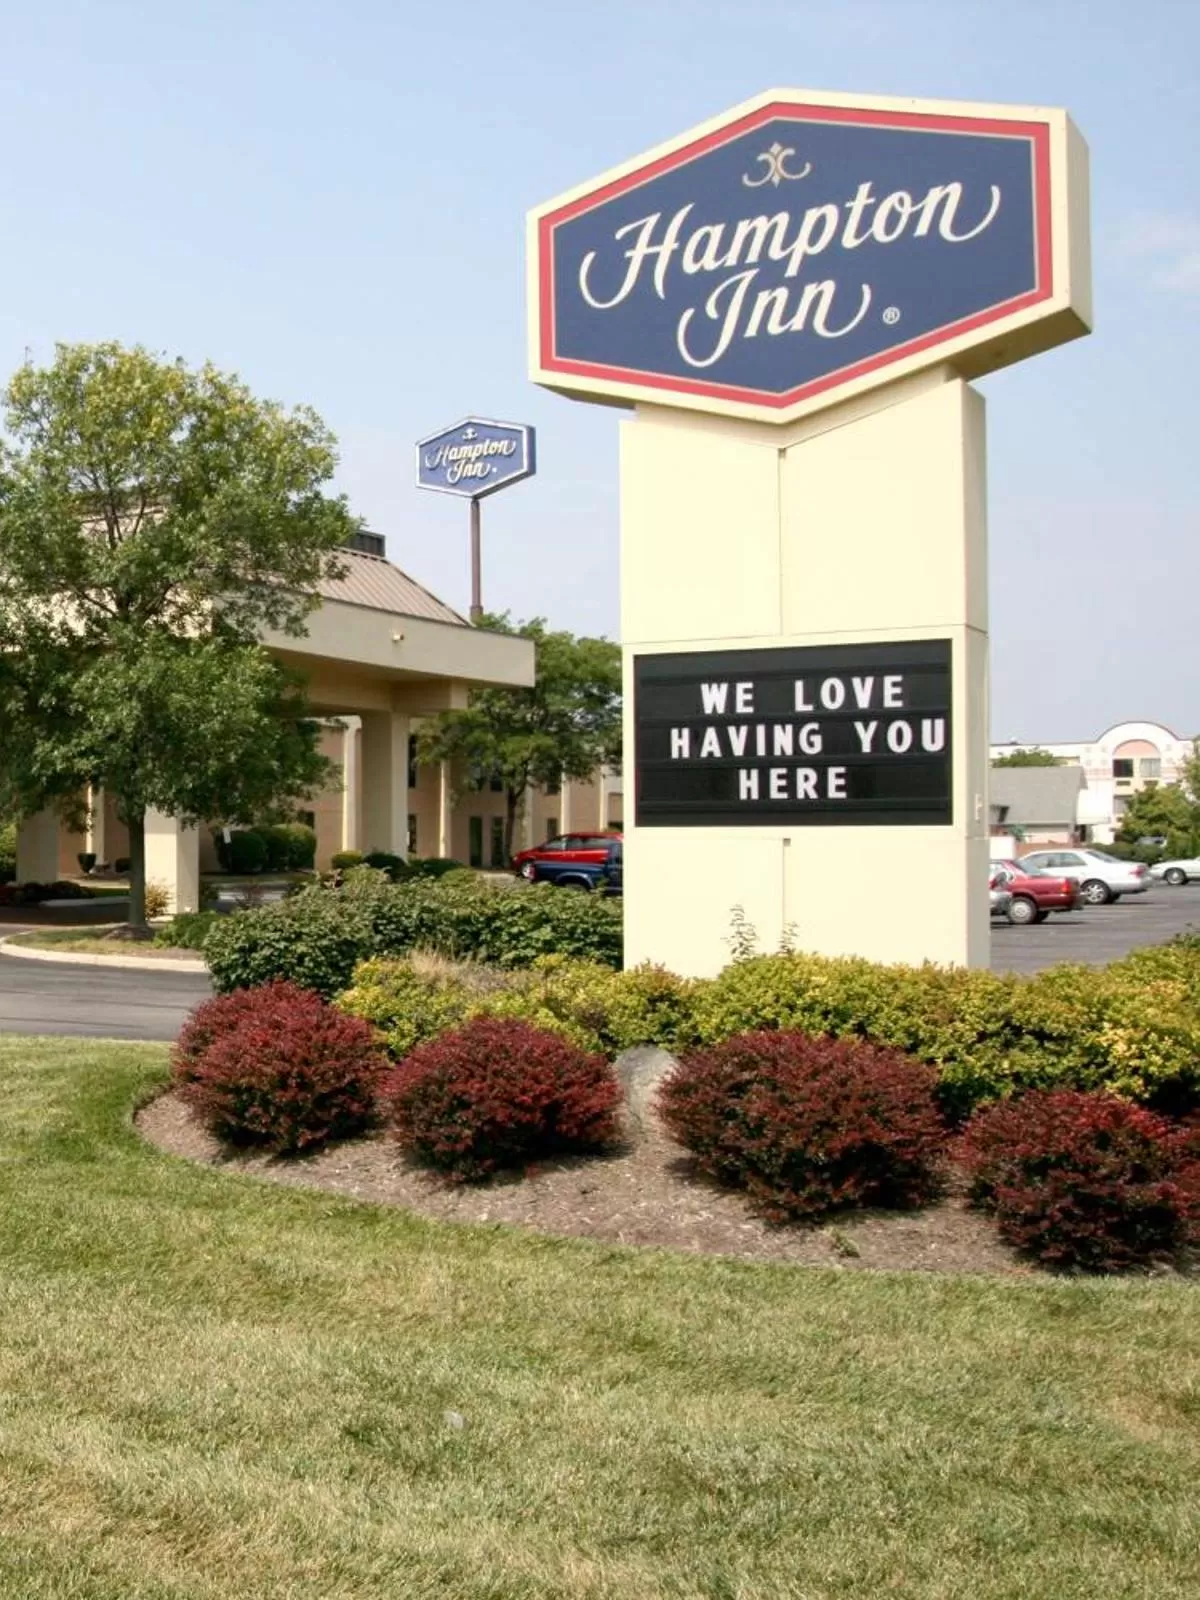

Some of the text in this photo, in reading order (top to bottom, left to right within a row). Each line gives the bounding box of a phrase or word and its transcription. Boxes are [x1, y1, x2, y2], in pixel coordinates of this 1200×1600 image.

[579, 180, 1000, 309] Hampton
[676, 267, 872, 368] Inn
[425, 438, 517, 469] Hampton
[446, 459, 491, 484] Inn
[700, 675, 904, 714] WE LOVE
[670, 718, 946, 759] HAVING YOU
[738, 766, 848, 800] HERE
